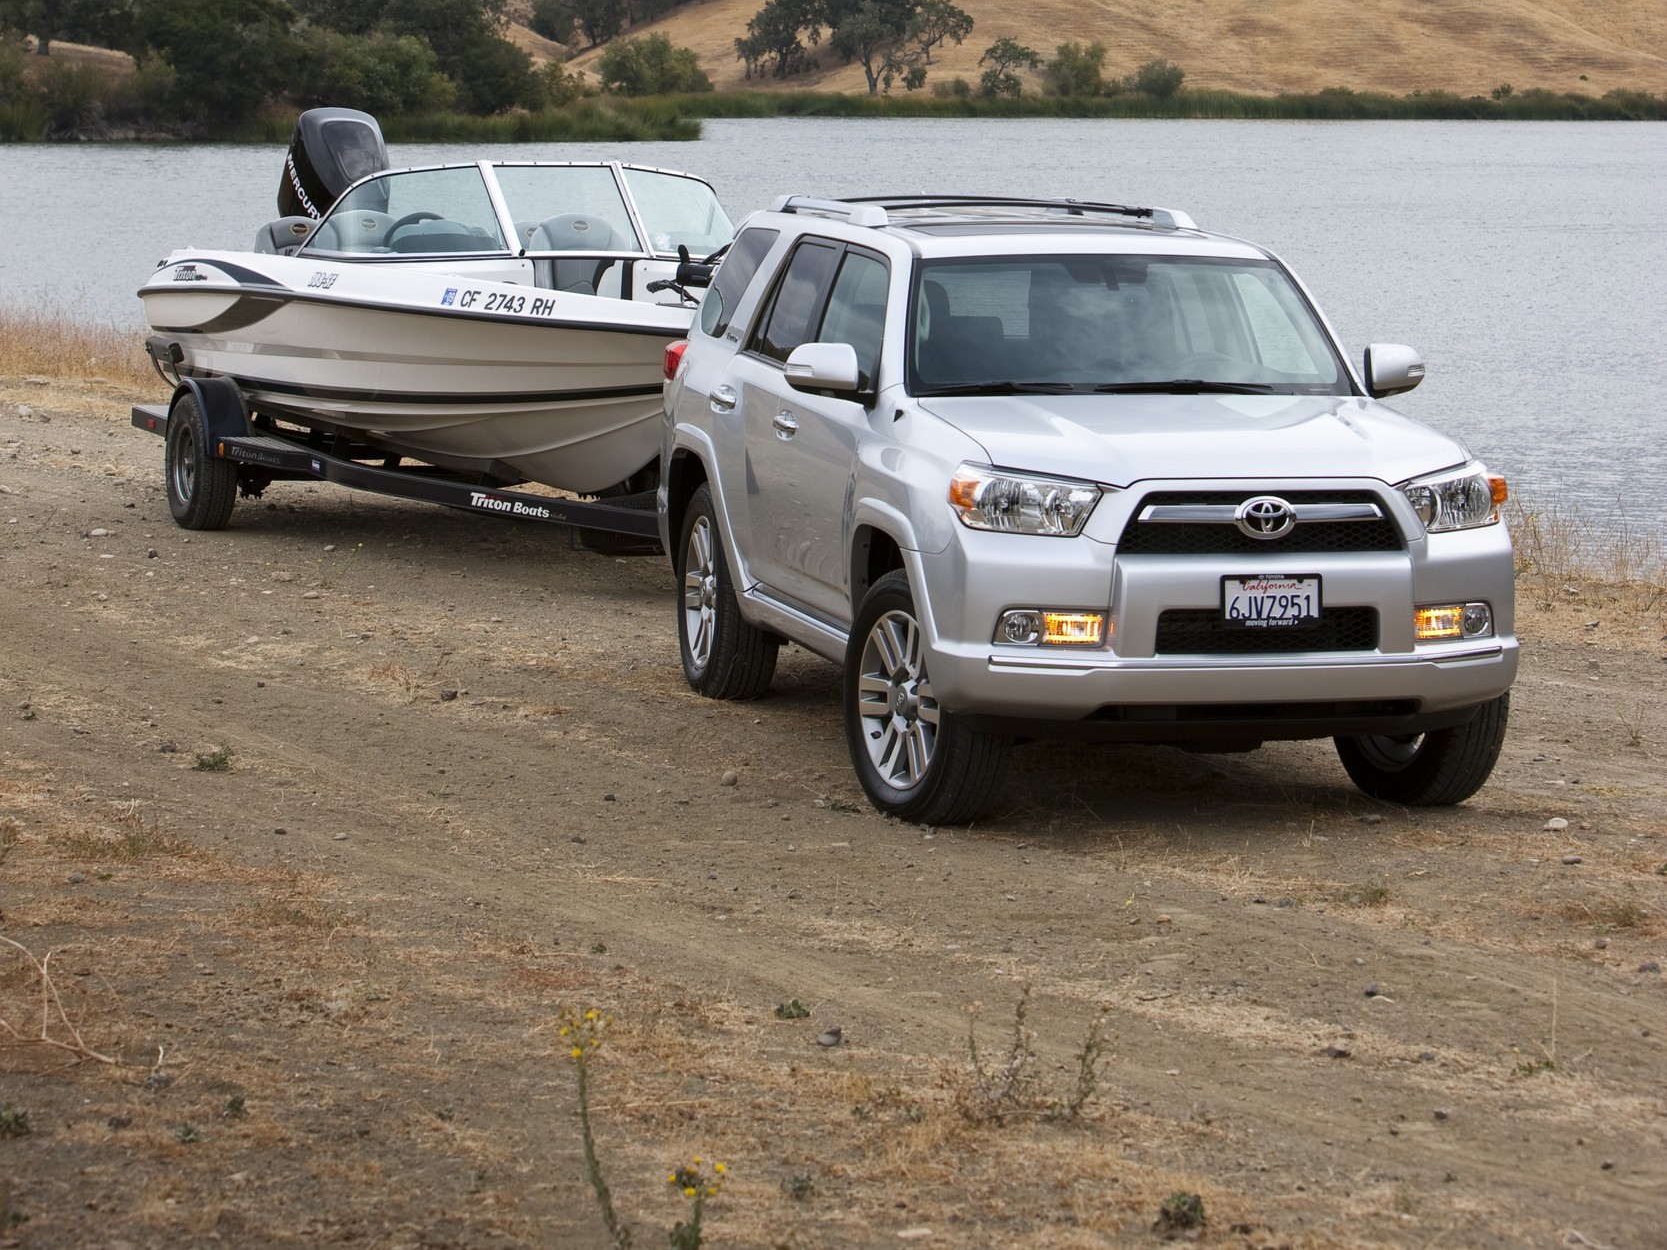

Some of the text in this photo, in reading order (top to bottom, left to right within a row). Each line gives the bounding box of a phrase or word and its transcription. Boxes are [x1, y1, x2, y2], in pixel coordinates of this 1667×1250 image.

[287, 153, 321, 222] MERCURY
[460, 290, 556, 316] CF 2743 RH
[231, 446, 257, 459] Triton
[470, 492, 512, 511] Triton
[513, 501, 550, 518] Boats
[1242, 579, 1303, 594] California
[1229, 594, 1314, 619] 6JVZ951
[1245, 618, 1293, 627] moving forward
